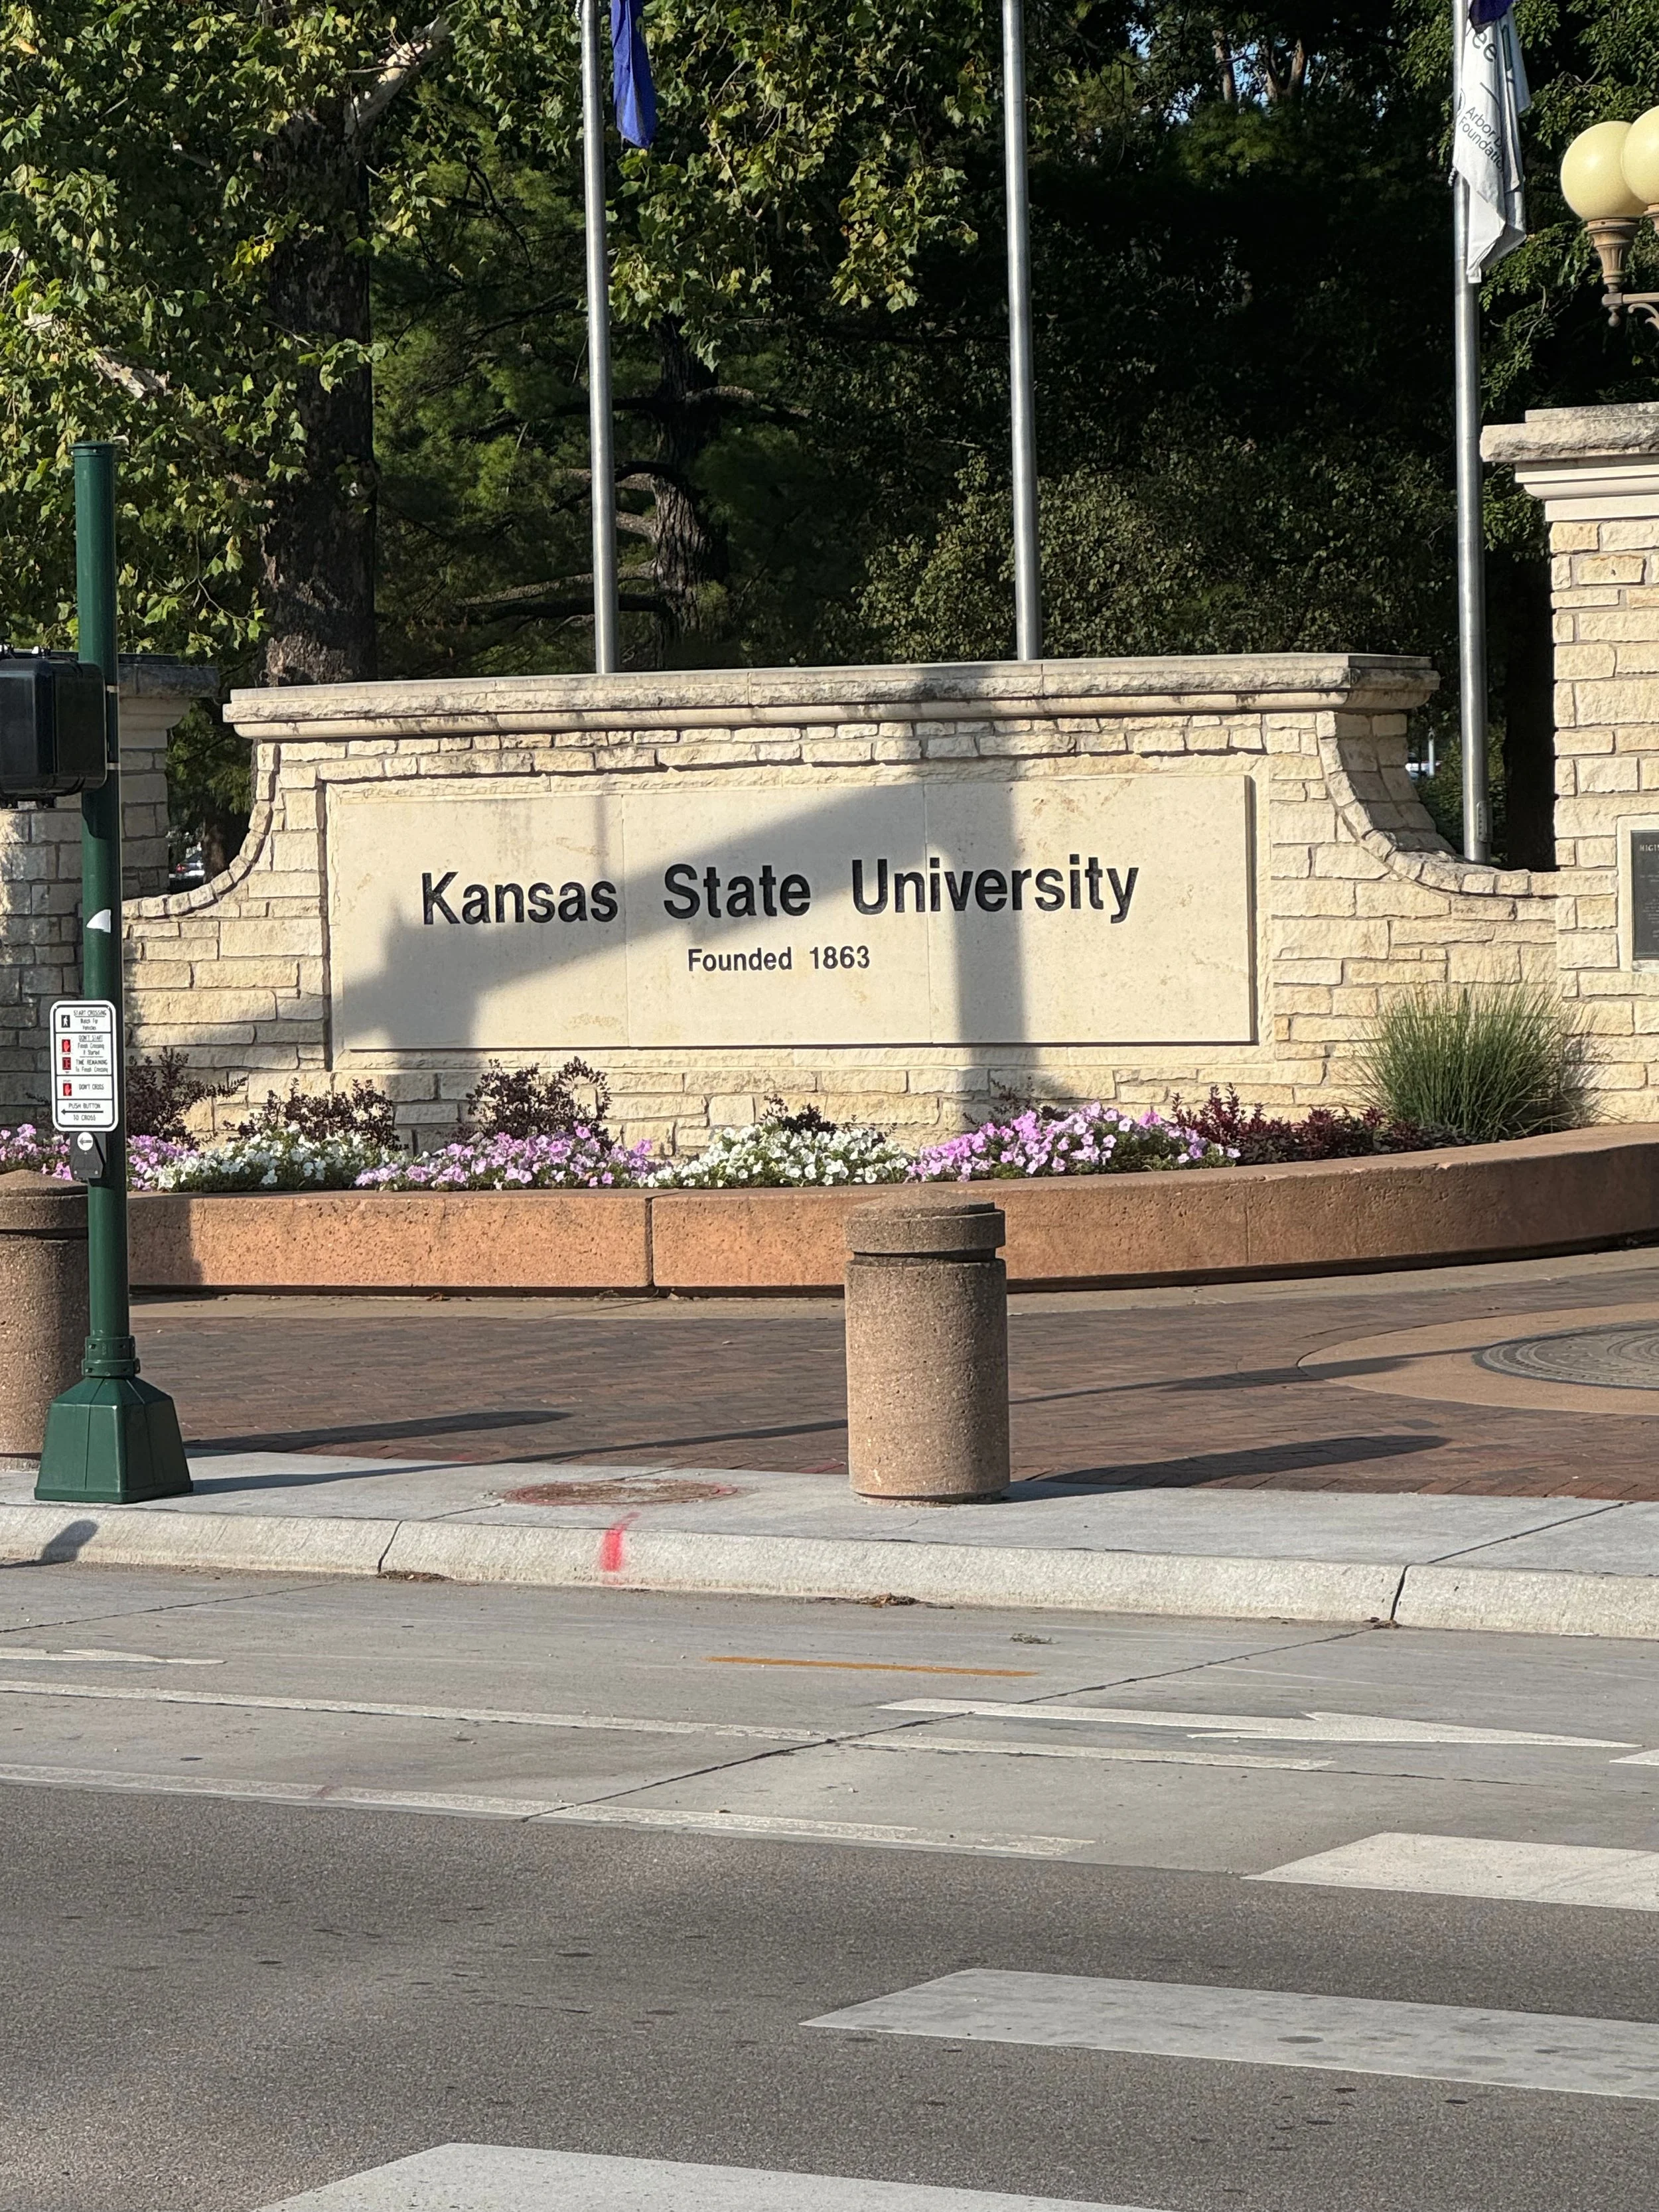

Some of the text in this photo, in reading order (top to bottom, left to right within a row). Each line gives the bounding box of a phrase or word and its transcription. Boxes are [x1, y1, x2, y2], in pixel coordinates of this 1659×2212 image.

[1465, 106, 1496, 137] Arbor
[421, 853, 1139, 925] Kansas State University
[687, 945, 871, 972] Founded 1863
